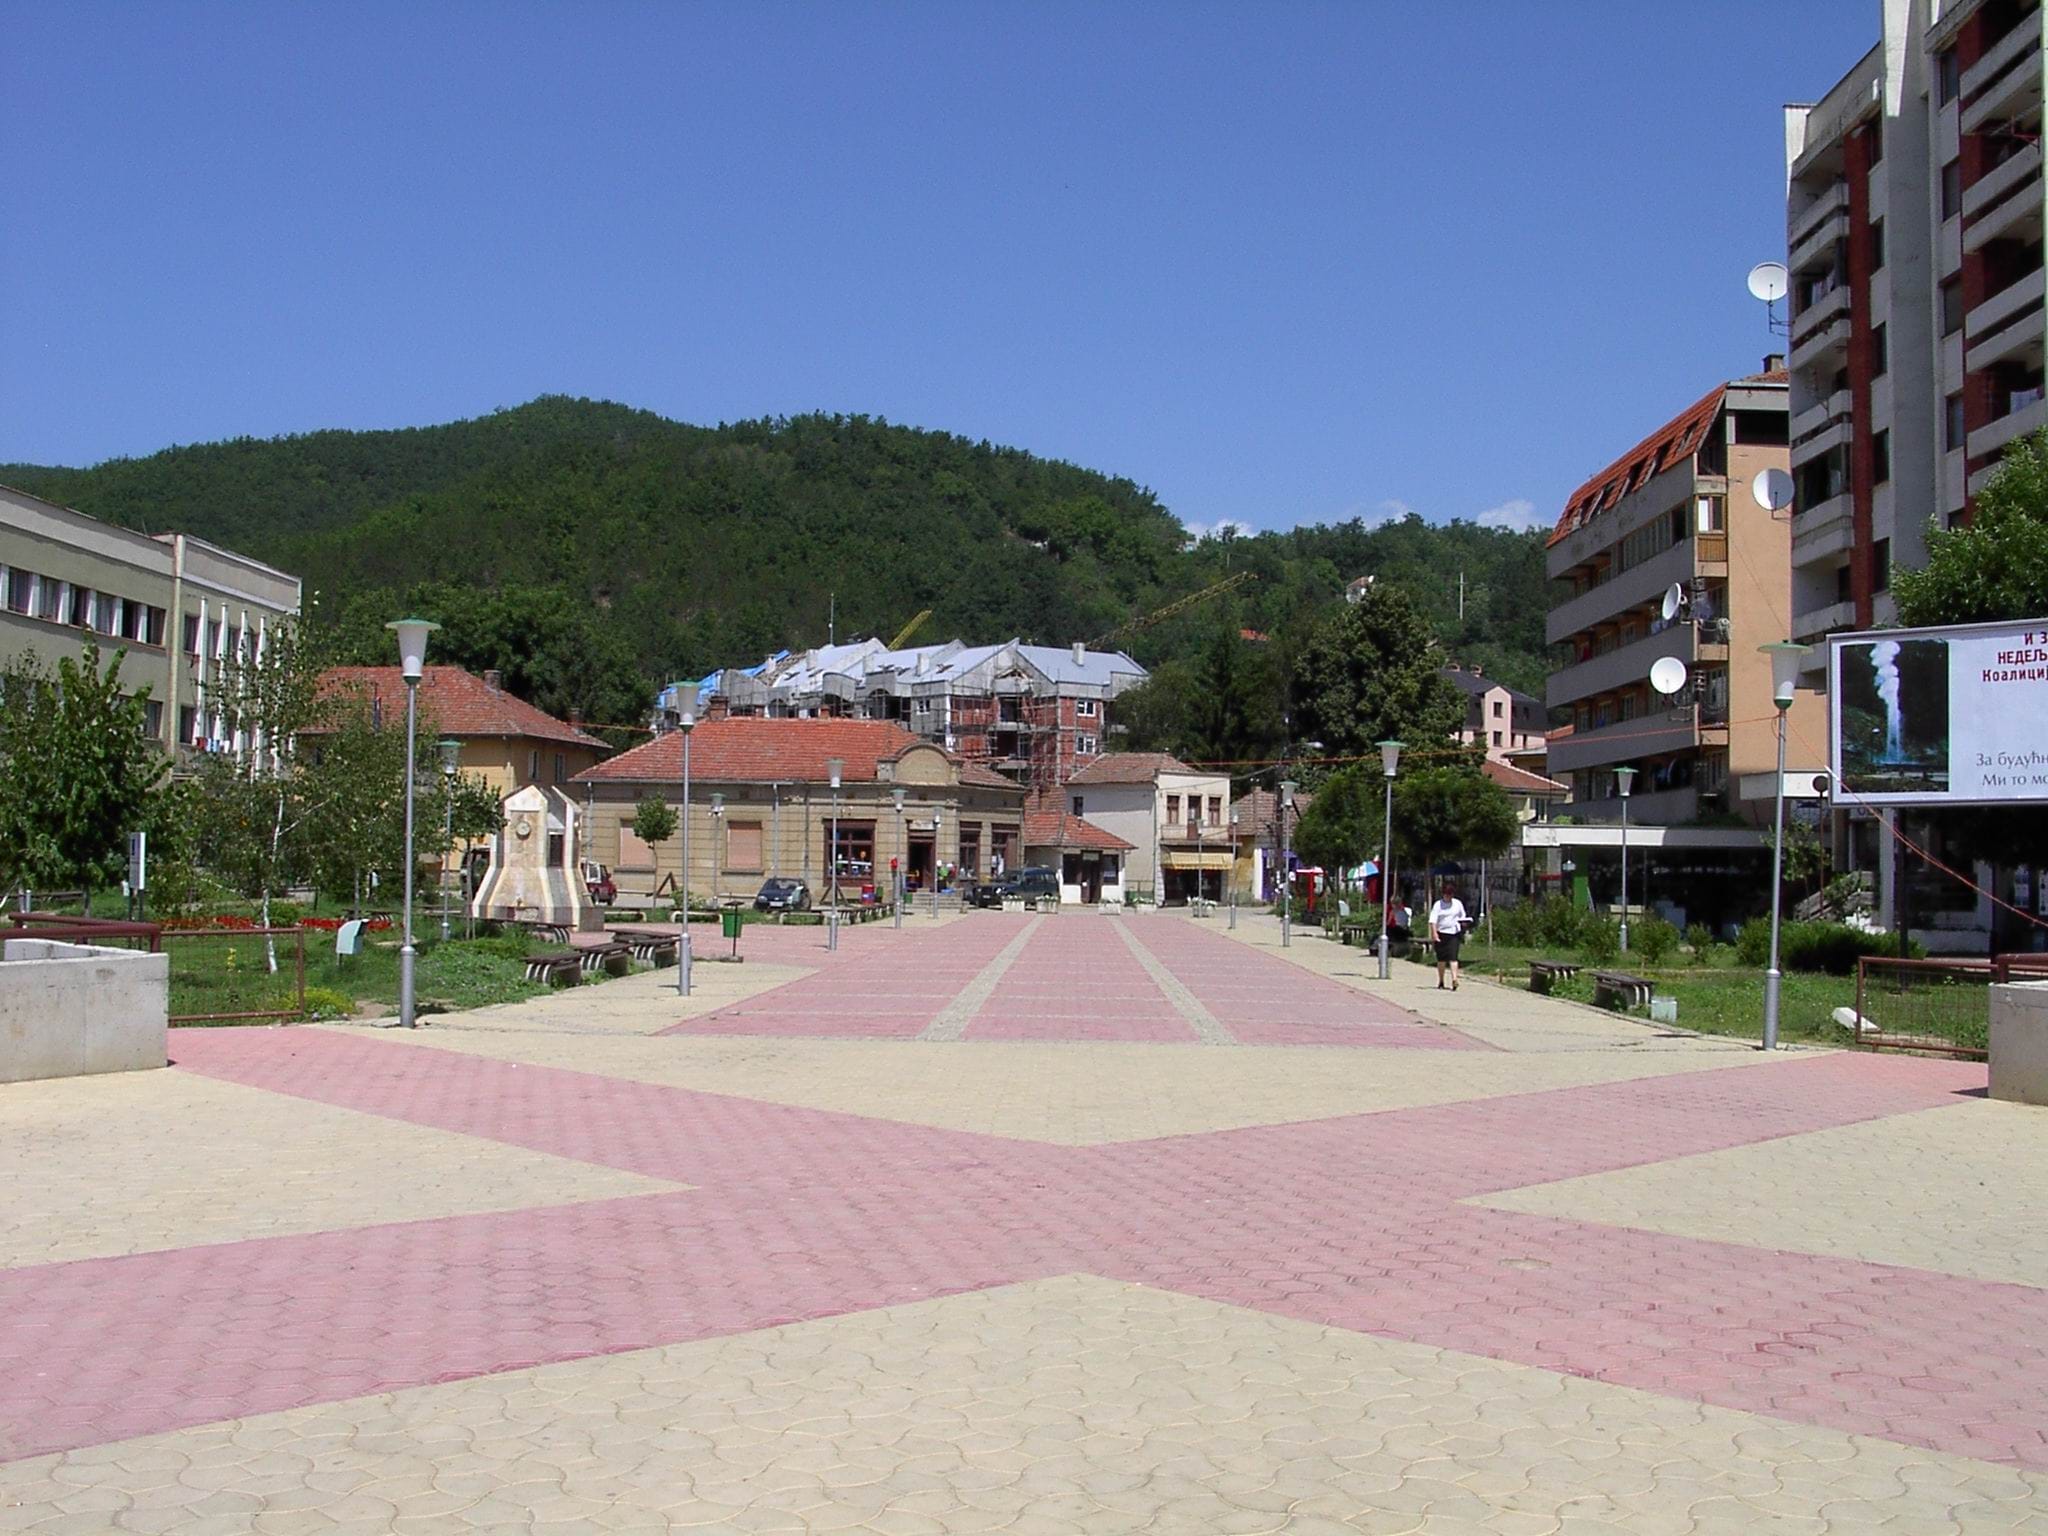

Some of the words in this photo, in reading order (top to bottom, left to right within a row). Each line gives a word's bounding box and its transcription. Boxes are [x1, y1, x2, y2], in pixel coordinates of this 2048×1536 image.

[2024, 632, 2033, 645] И
[1998, 649, 2048, 665] НЕДЕЉ
[1976, 753, 1992, 766] За
[1982, 773, 2006, 786] Ми
[2011, 776, 2027, 785] то
